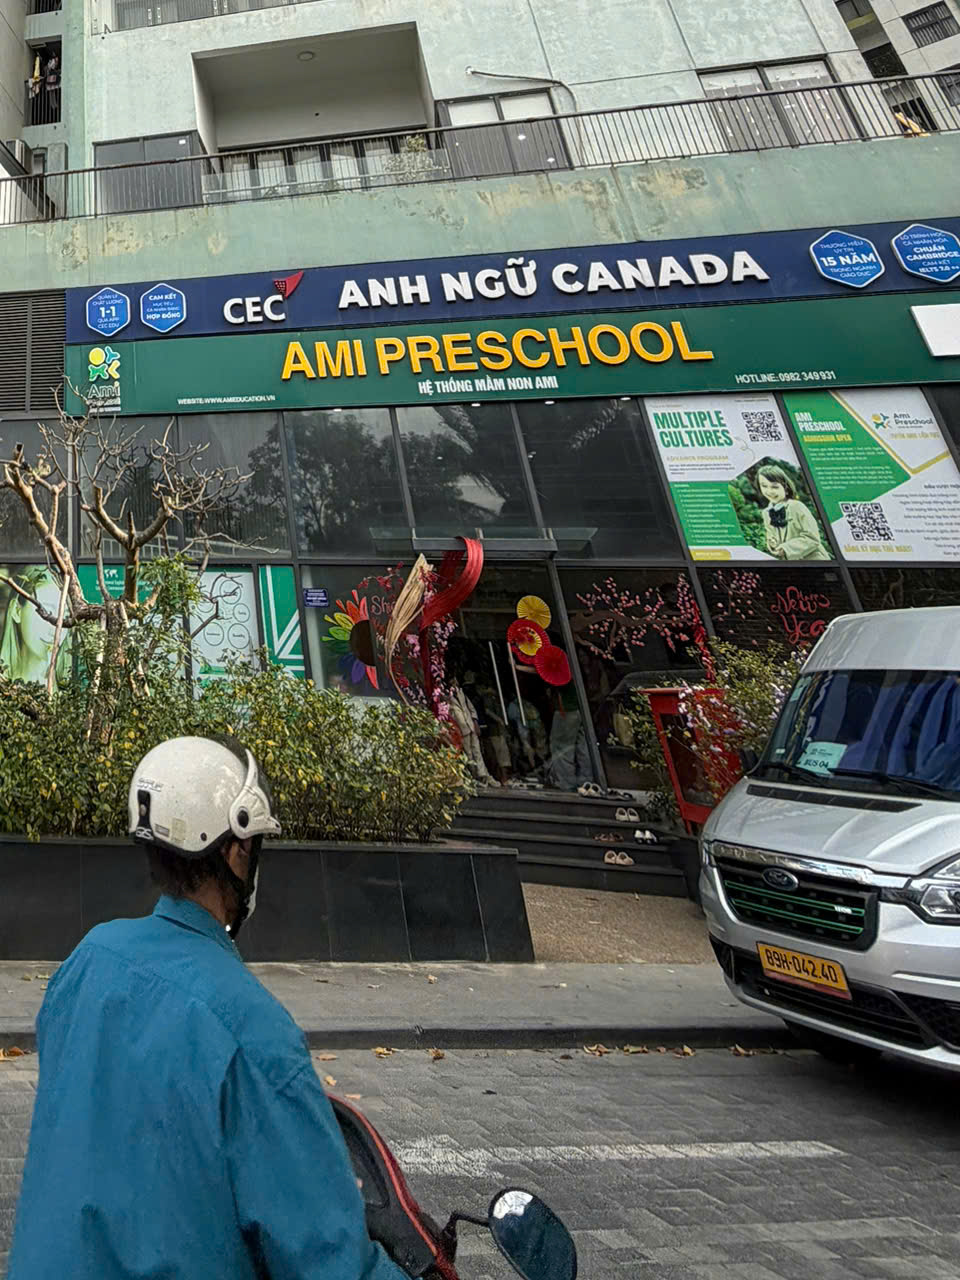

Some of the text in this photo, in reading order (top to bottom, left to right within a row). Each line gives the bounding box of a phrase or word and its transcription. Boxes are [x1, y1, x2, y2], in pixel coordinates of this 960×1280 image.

[820, 252, 877, 267] 15 NĂM
[338, 250, 771, 309] ANH NGỮ CANADA
[99, 305, 116, 318] 1-1
[223, 294, 287, 325] CEC
[281, 321, 715, 381] AMI PRESCHOOL
[418, 379, 434, 396] HỆ
[507, 376, 533, 391] NON
[535, 375, 559, 389] AMI
[653, 410, 727, 429] MULTIPLE
[794, 412, 813, 422] AMI
[798, 421, 847, 432] PRESCHOOL
[895, 417, 934, 425] Preschool
[659, 429, 734, 448] CULTURES
[780, 614, 826, 644] Yea
[764, 948, 839, 984] 89H-042.40
